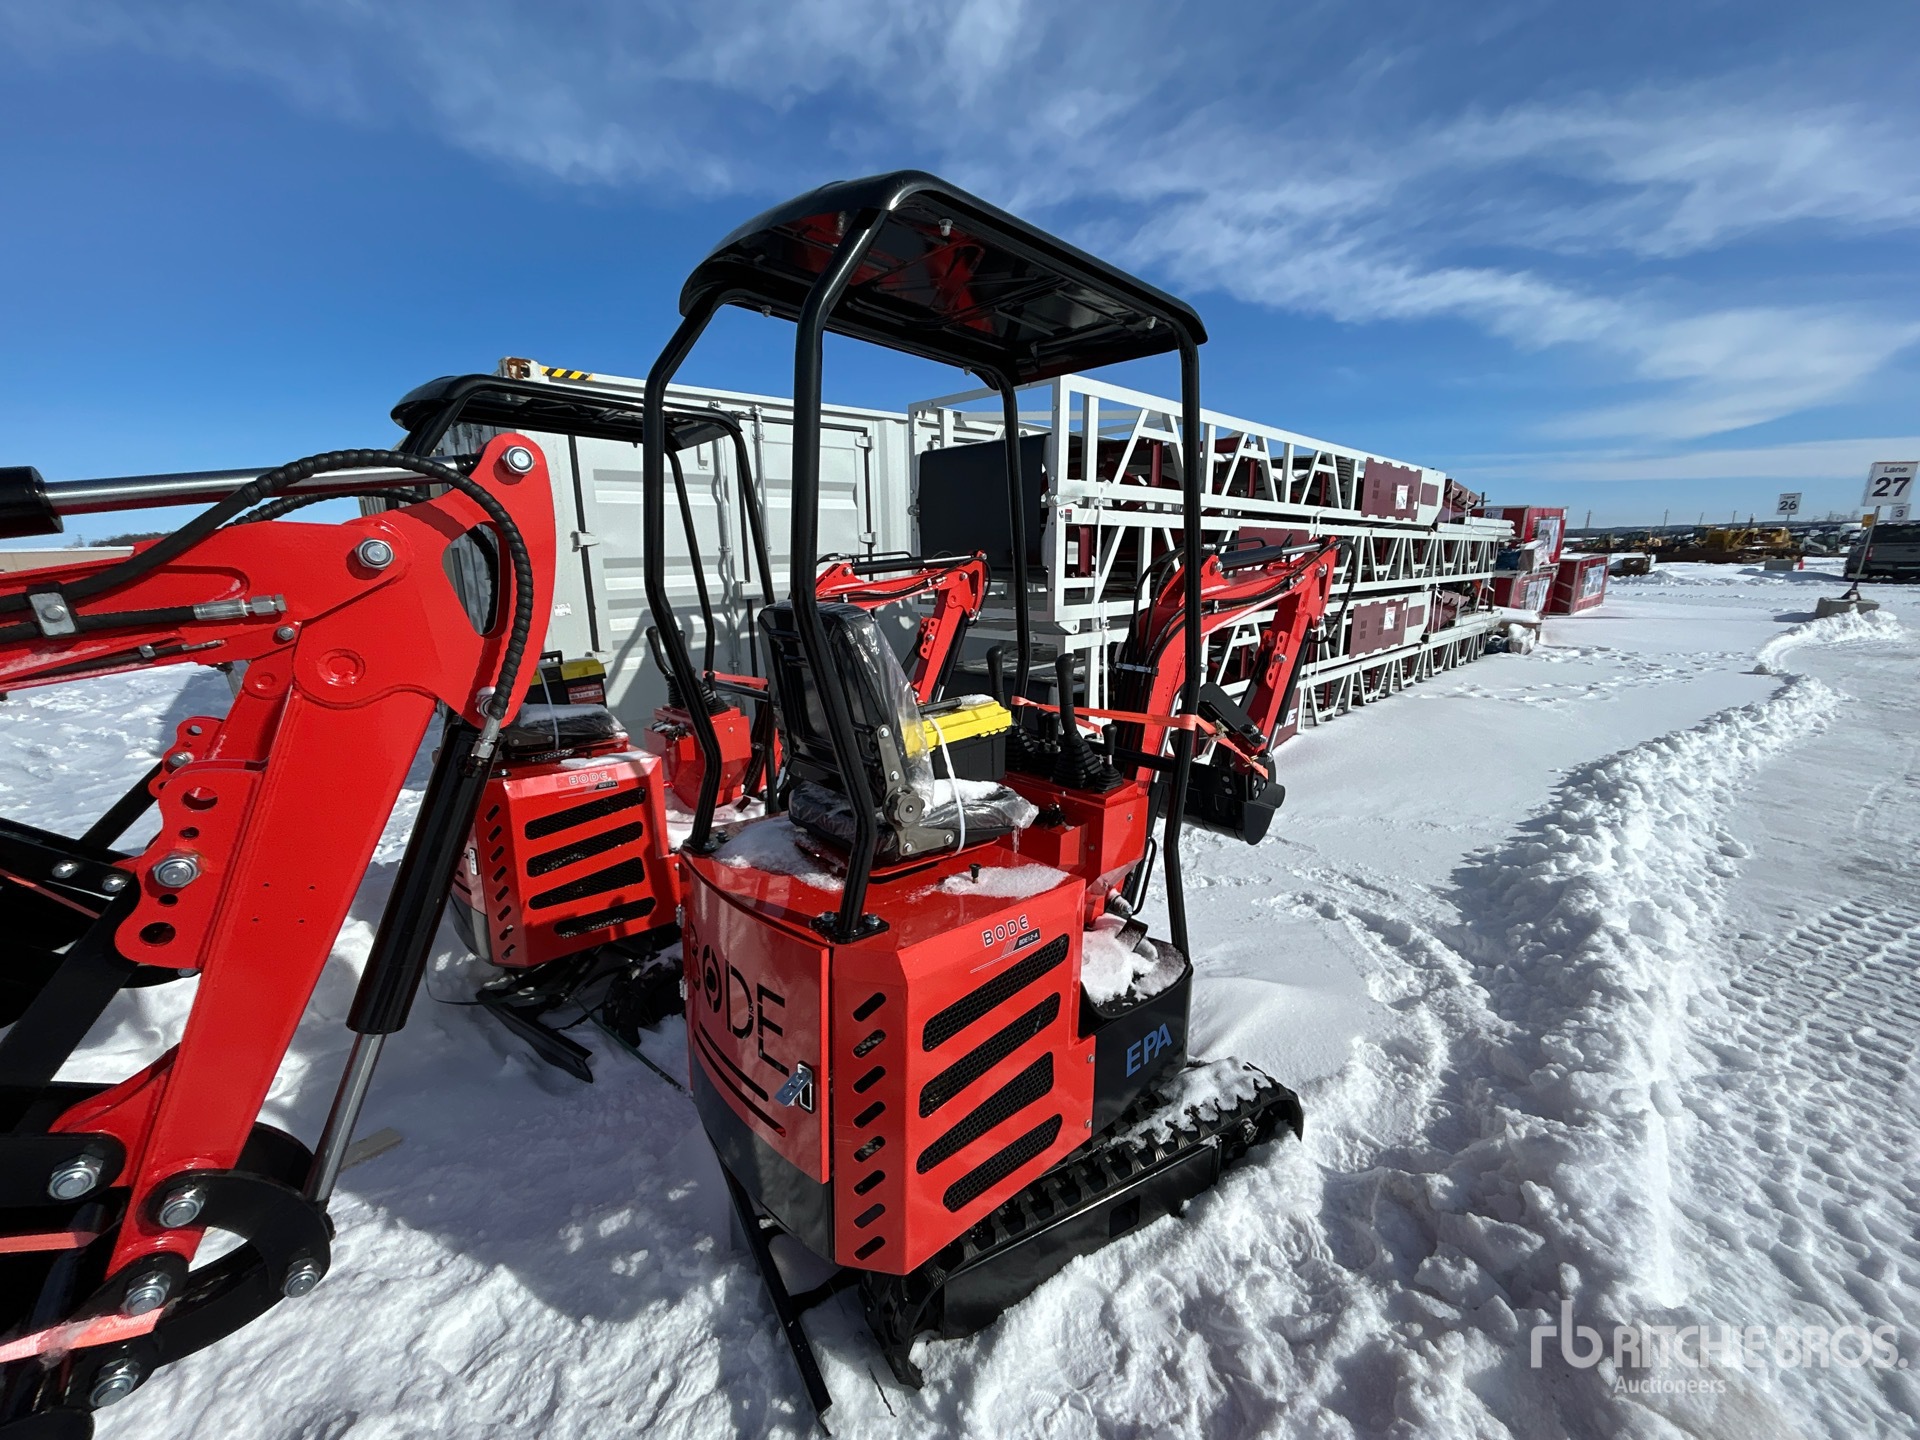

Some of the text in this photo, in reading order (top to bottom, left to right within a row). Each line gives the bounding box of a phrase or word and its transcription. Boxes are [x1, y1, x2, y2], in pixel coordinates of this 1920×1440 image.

[1884, 466, 1908, 474] Lane
[1872, 477, 1911, 497] 27
[1779, 500, 1797, 511] 26
[568, 771, 608, 785] BODE
[982, 914, 1029, 948] BODE
[1126, 1022, 1172, 1078] EPA
